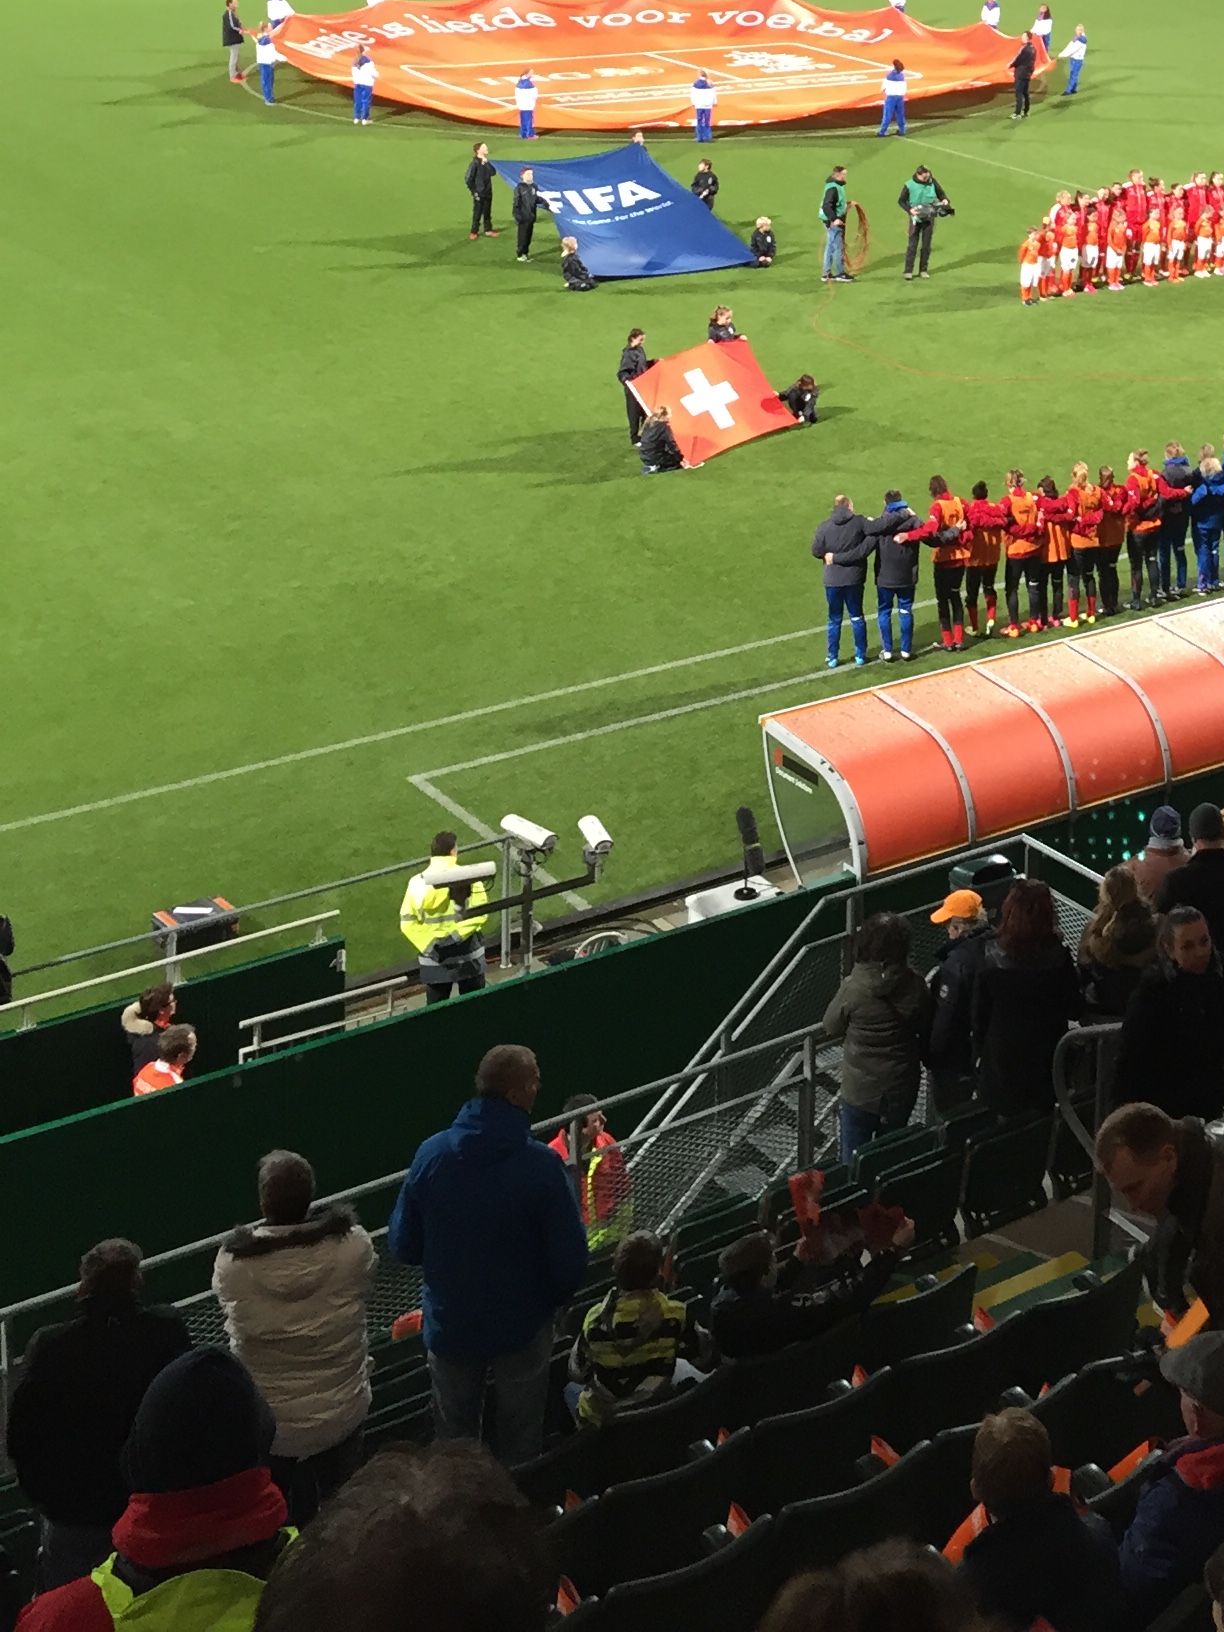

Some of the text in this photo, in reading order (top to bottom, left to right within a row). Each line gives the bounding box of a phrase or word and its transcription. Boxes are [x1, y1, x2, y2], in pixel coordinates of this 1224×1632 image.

[361, 21, 415, 39] is
[404, 7, 556, 33] liefde
[569, 9, 691, 28] voor
[708, 9, 893, 44] voetbal
[536, 180, 662, 215] FIFA
